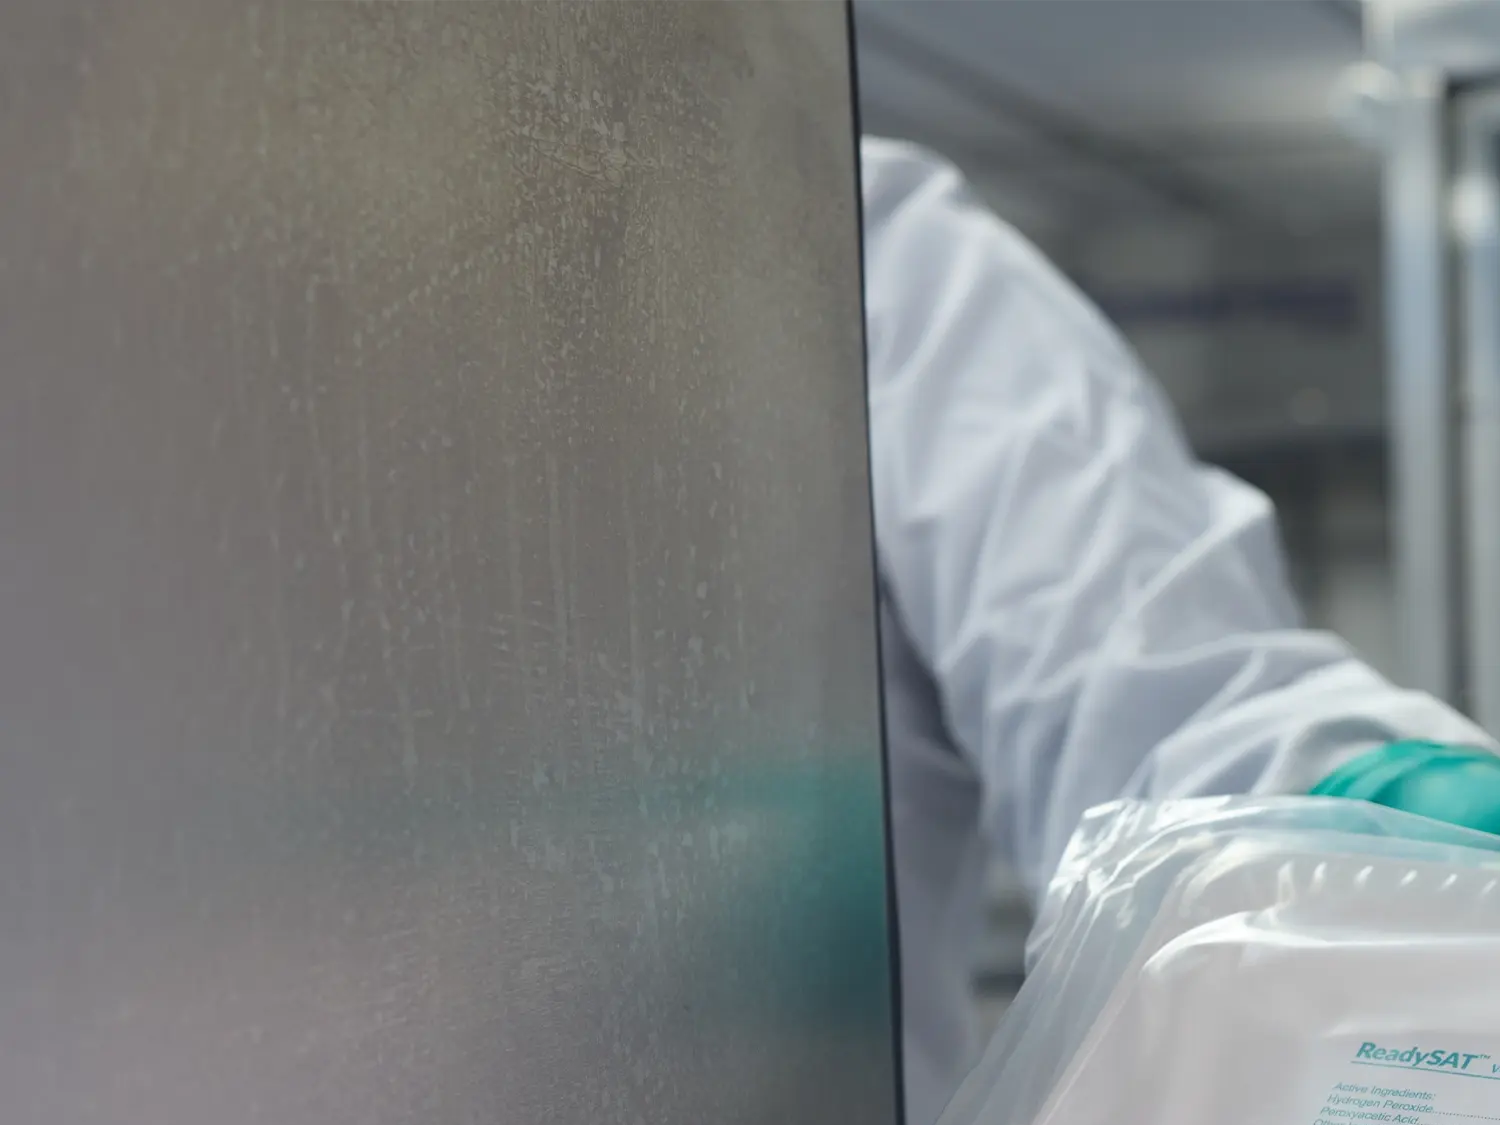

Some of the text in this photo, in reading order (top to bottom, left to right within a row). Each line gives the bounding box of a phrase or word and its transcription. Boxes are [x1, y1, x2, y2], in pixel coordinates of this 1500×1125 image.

[1333, 1082, 1436, 1100] Active Ingredients:
[1327, 1094, 1380, 1108] Hydrogen
[1383, 1100, 1433, 1113] Peroxide
